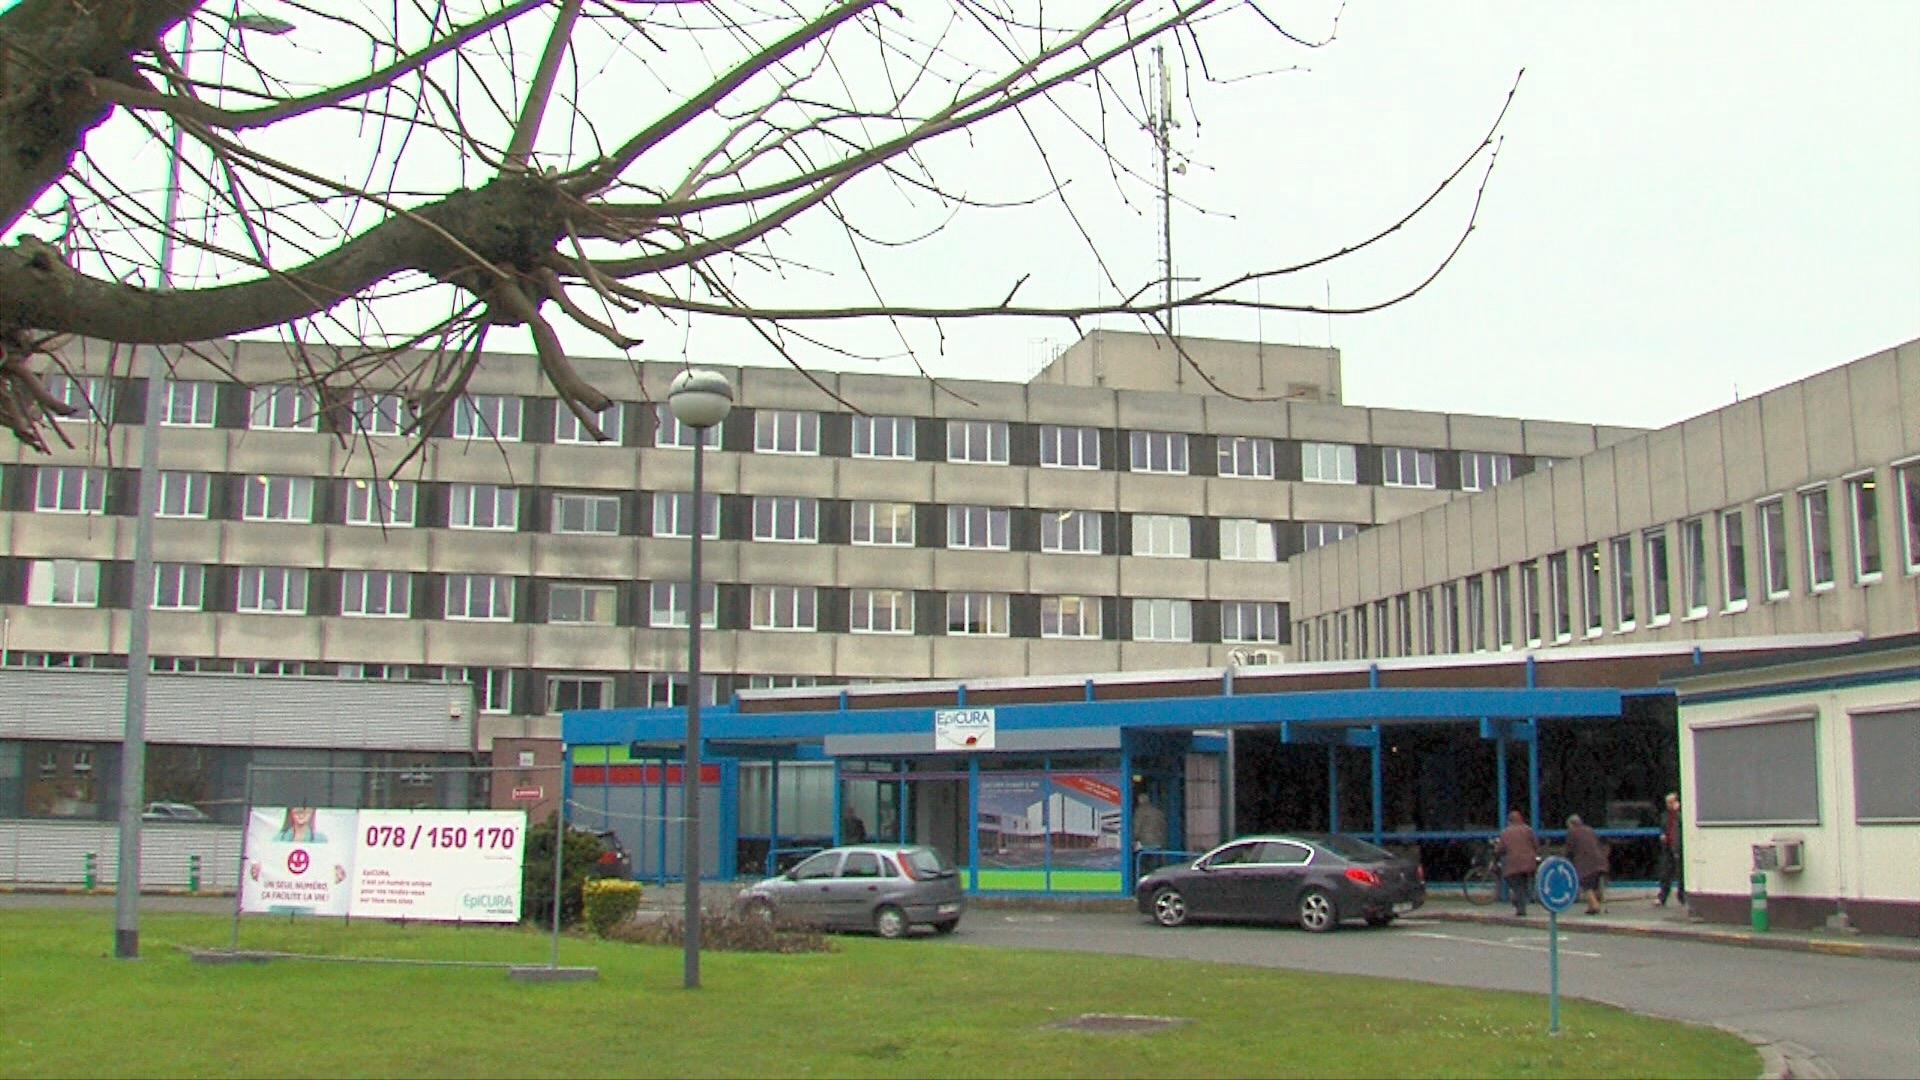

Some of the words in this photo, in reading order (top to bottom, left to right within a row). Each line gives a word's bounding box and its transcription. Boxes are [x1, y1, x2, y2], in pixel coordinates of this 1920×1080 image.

[937, 711, 990, 726] EpiCURA
[366, 826, 405, 847] 078
[410, 825, 422, 849] /
[427, 827, 467, 848] 150
[276, 881, 293, 890] SEUL
[272, 891, 302, 900] FACILITE
[303, 892, 313, 900] LA
[464, 894, 514, 908] EpiCURA
